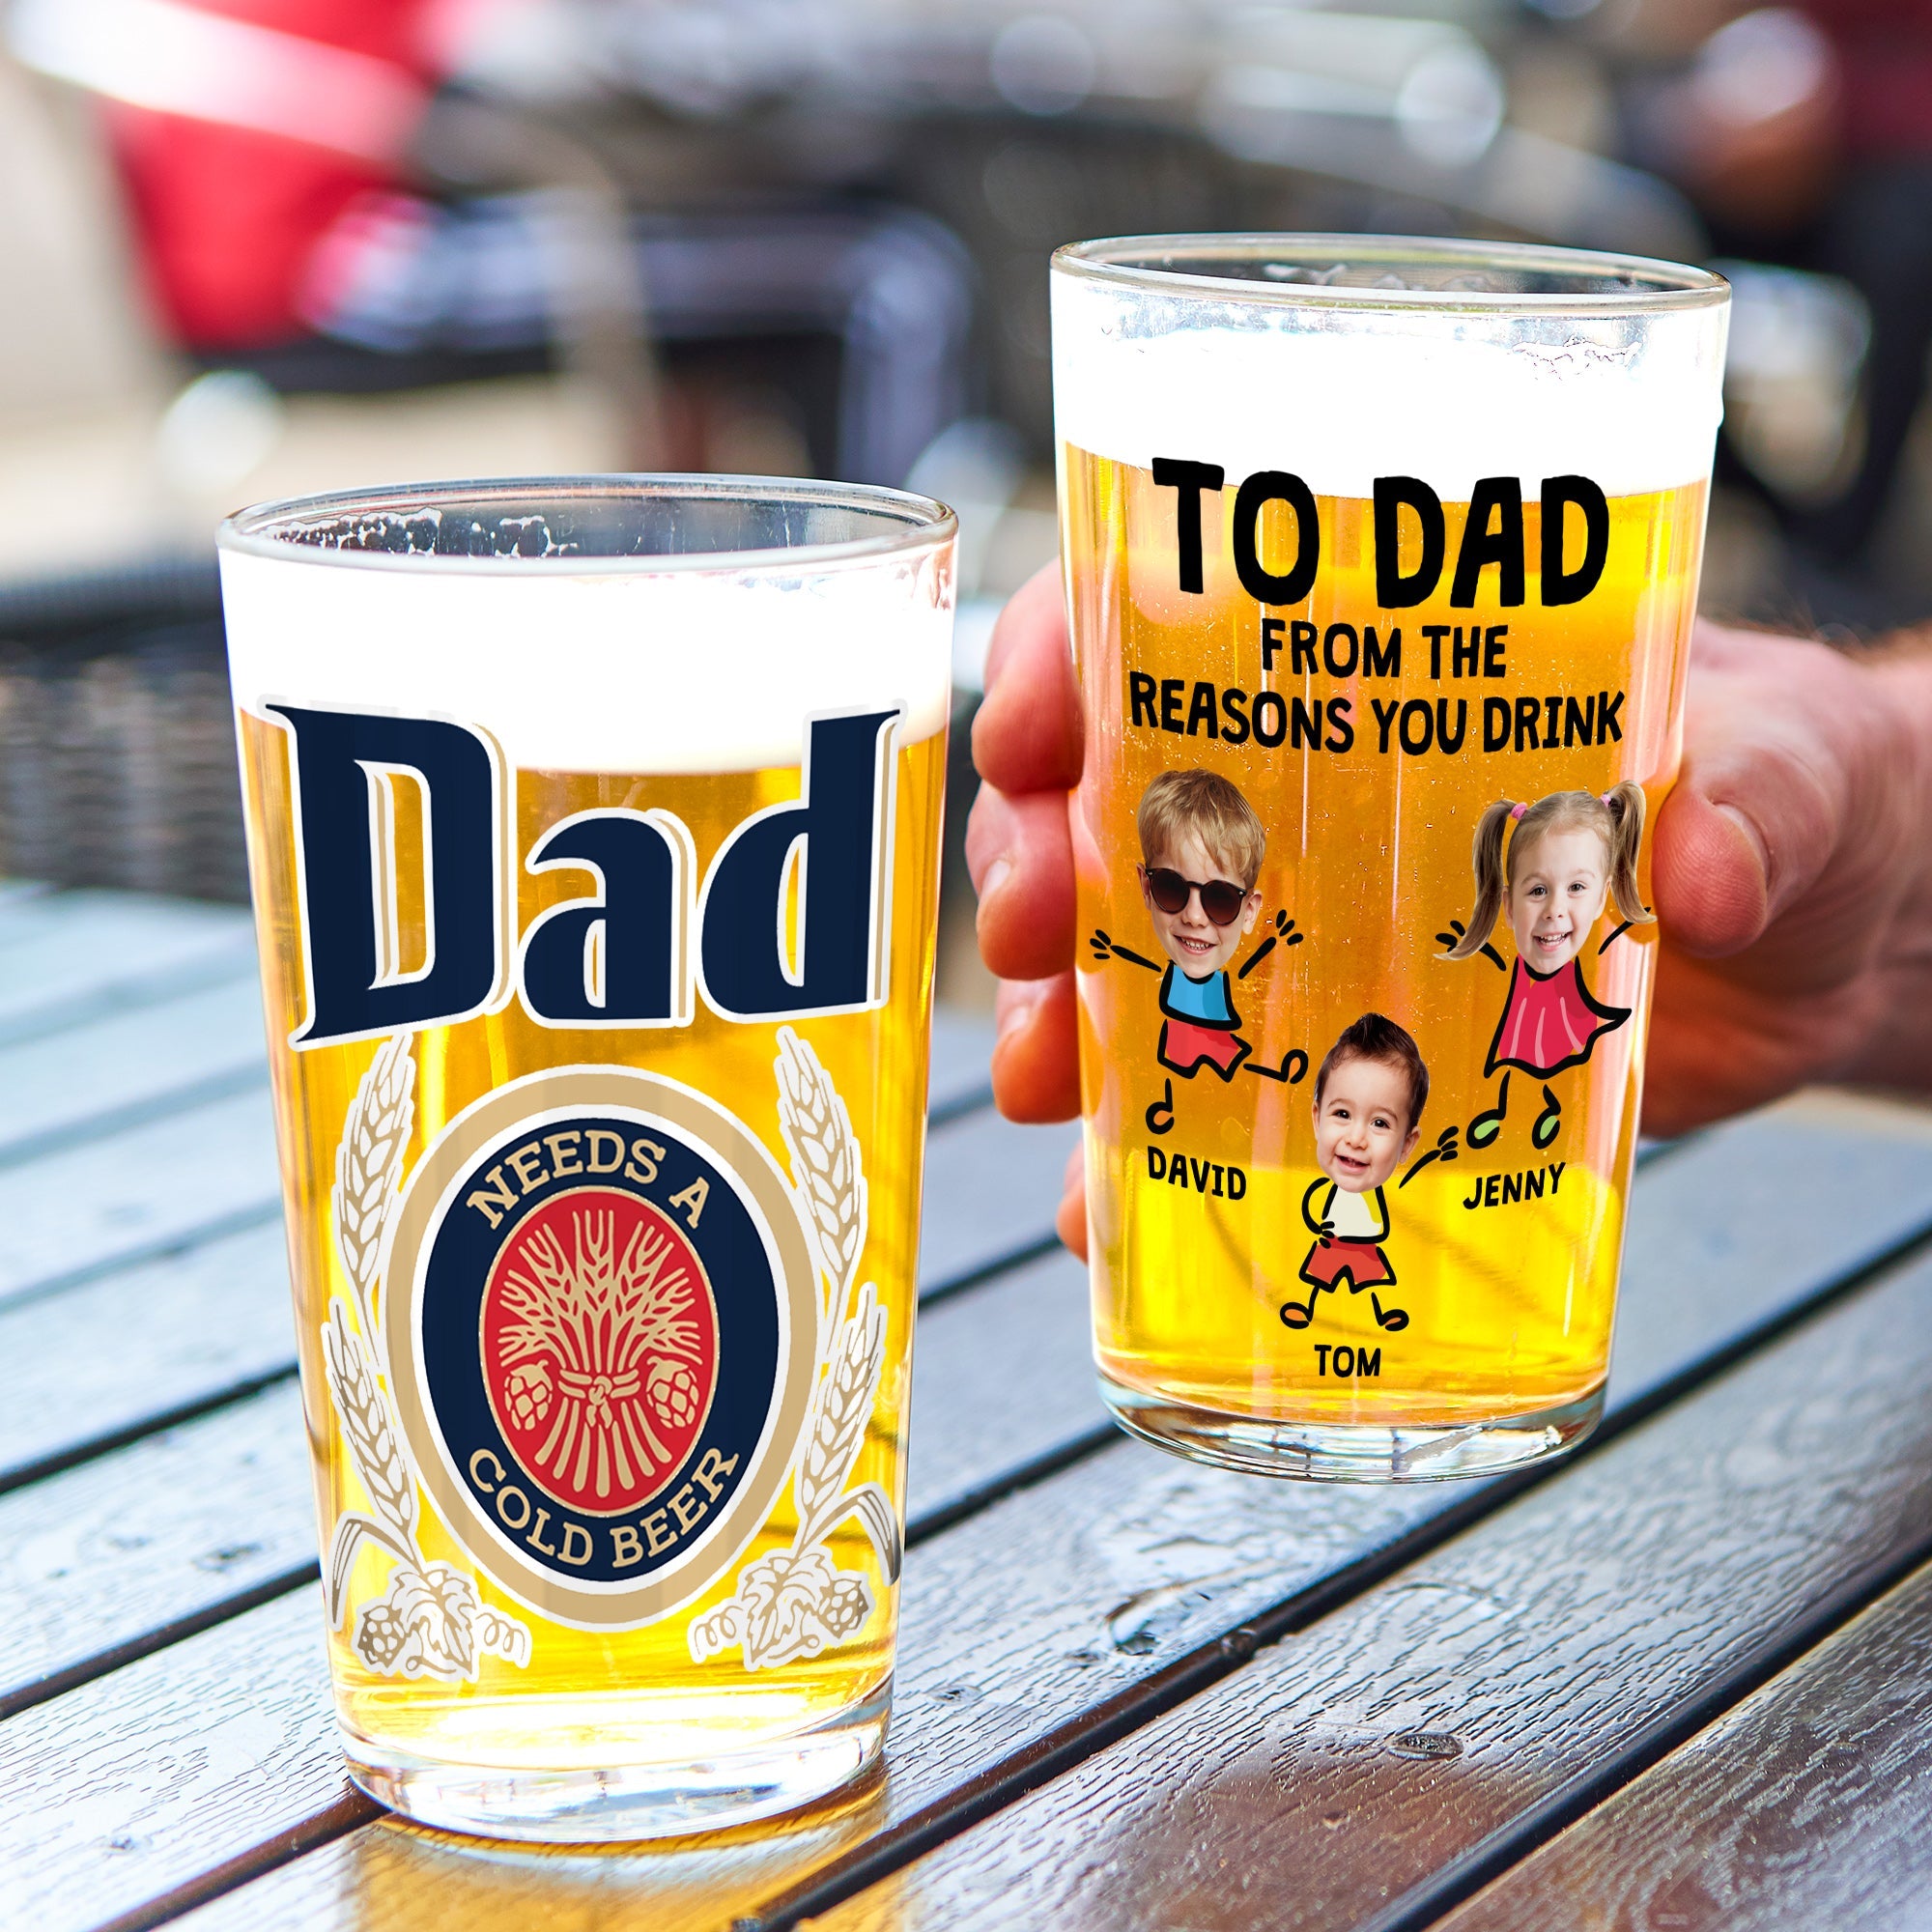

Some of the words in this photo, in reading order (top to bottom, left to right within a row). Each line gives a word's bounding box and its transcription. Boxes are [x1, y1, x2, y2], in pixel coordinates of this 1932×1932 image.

[1151, 457, 1320, 607] TO
[1373, 474, 1609, 609] DAD
[1262, 617, 1402, 678] FROM
[1422, 624, 1509, 678] THE
[1127, 671, 1354, 753] REASONS
[1371, 697, 1467, 754] YOU
[1483, 691, 1625, 753] DRINK
[259, 696, 906, 1050] Dad
[466, 1128, 668, 1230] NEEDS
[668, 1176, 710, 1229] A
[1147, 1146, 1247, 1201] DAVID
[1462, 1162, 1567, 1210] JENNY
[1314, 1344, 1382, 1378] TOM
[469, 1448, 593, 1567] COLD
[610, 1447, 740, 1569] BEER
